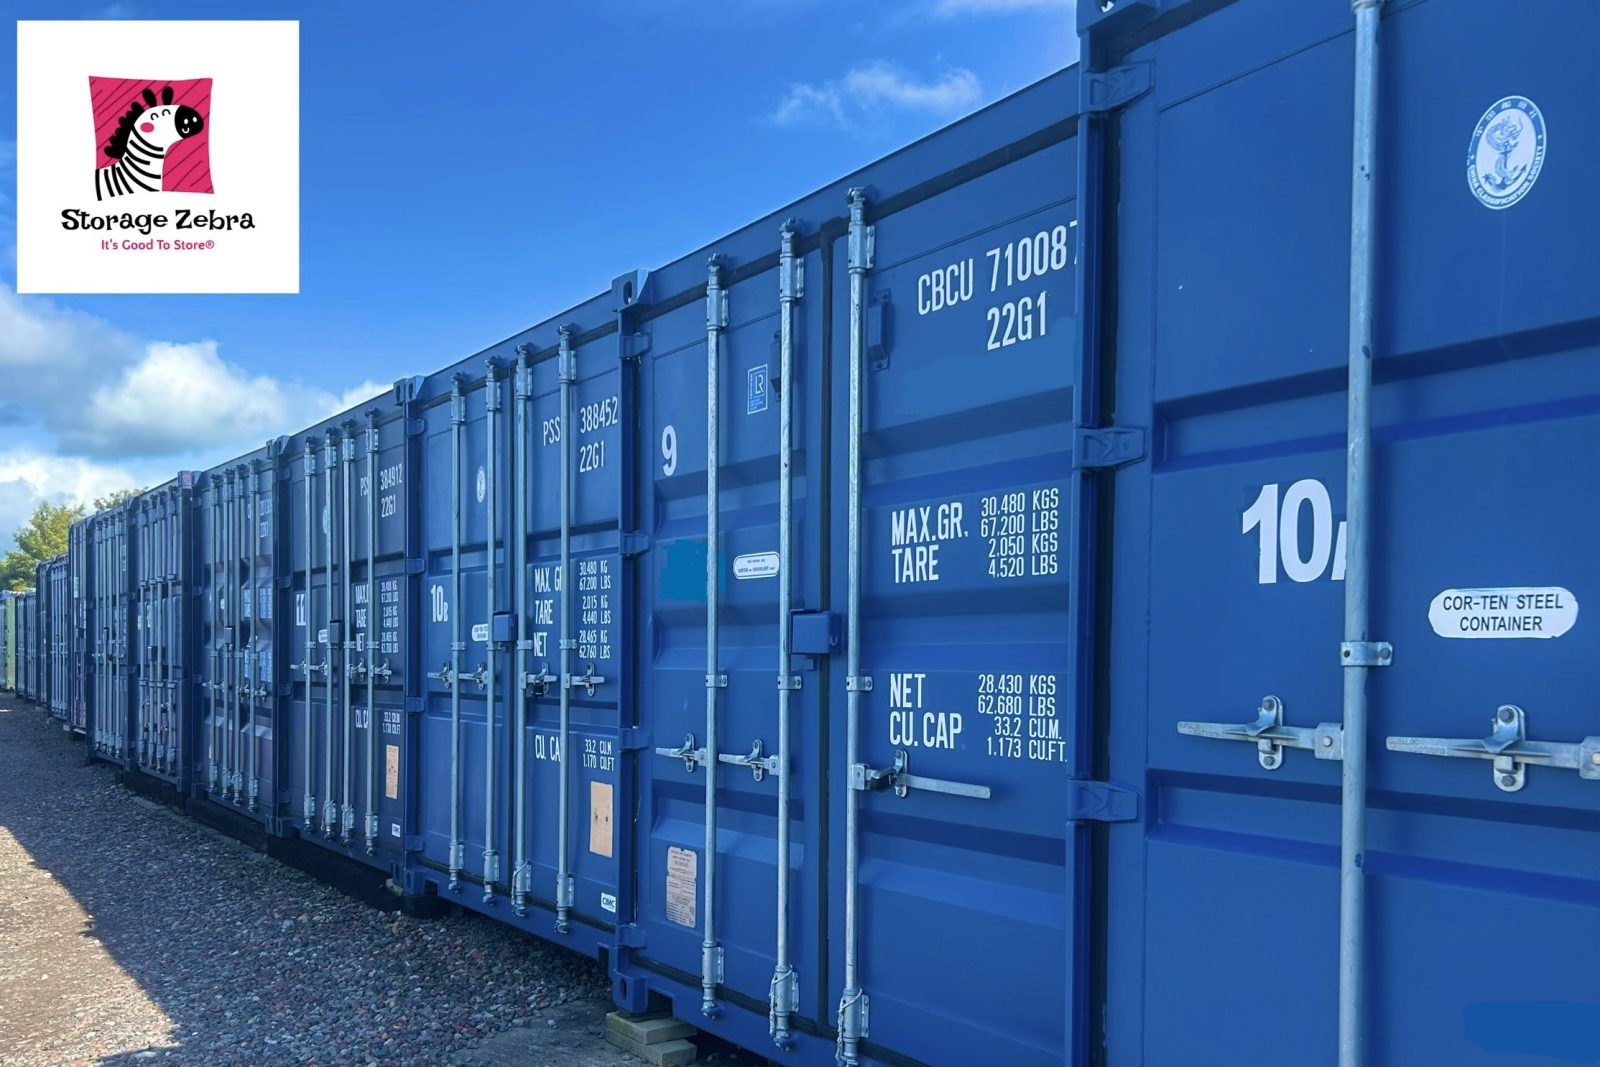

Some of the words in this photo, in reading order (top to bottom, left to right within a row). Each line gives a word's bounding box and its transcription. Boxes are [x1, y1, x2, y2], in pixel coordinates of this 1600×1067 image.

[917, 258, 974, 316] CBCU
[987, 291, 1046, 351] 22G1
[543, 416, 561, 447] PSS
[580, 396, 618, 434] 388452
[580, 440, 604, 473] 22G1
[661, 425, 677, 477] 9
[381, 494, 396, 518] 22G1
[1032, 488, 1059, 511] KGS
[1032, 510, 1059, 533] LBS
[600, 559, 608, 574] KG
[892, 544, 939, 584] TARE
[1032, 532, 1058, 554] KGS
[1032, 554, 1058, 576] LBS
[600, 575, 611, 590] LBS
[430, 584, 448, 623] 10B
[535, 599, 553, 625] TARE
[600, 594, 608, 609] KG
[1443, 595, 1508, 611] COR-TEN
[1517, 594, 1564, 610] STEEL
[600, 610, 611, 625] LBS
[1460, 617, 1543, 632] CONTAINER
[533, 632, 548, 657] NET
[600, 629, 608, 644] KG
[600, 644, 611, 659] LBS
[890, 673, 926, 708] NET
[1029, 674, 1056, 695] KGS
[1029, 696, 1055, 717] LBS
[994, 716, 1021, 737] 33.2
[550, 736, 561, 762] CA
